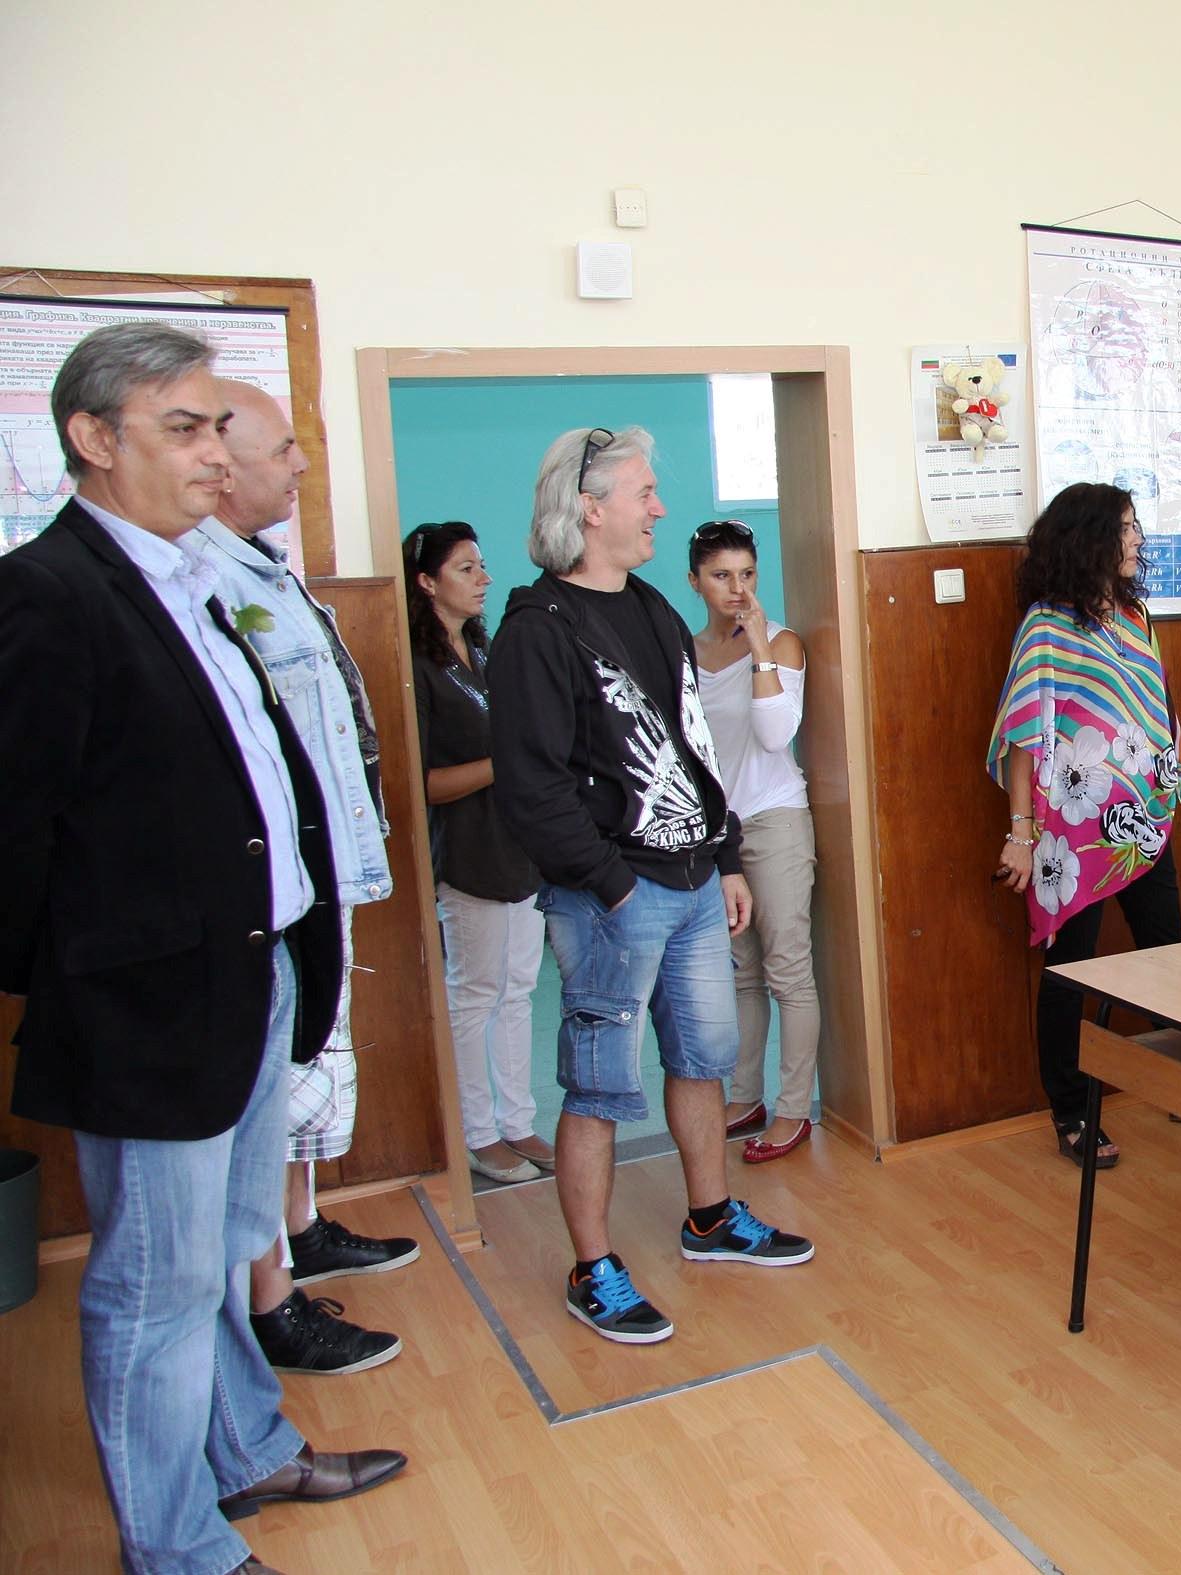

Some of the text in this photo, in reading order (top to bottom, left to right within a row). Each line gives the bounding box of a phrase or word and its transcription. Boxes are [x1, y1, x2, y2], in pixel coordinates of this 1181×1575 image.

[1071, 246, 1169, 262] РОТАЦИОННИ
[26, 310, 78, 322] Графика.
[209, 319, 276, 331] неравенства.
[659, 828, 691, 846] KING
